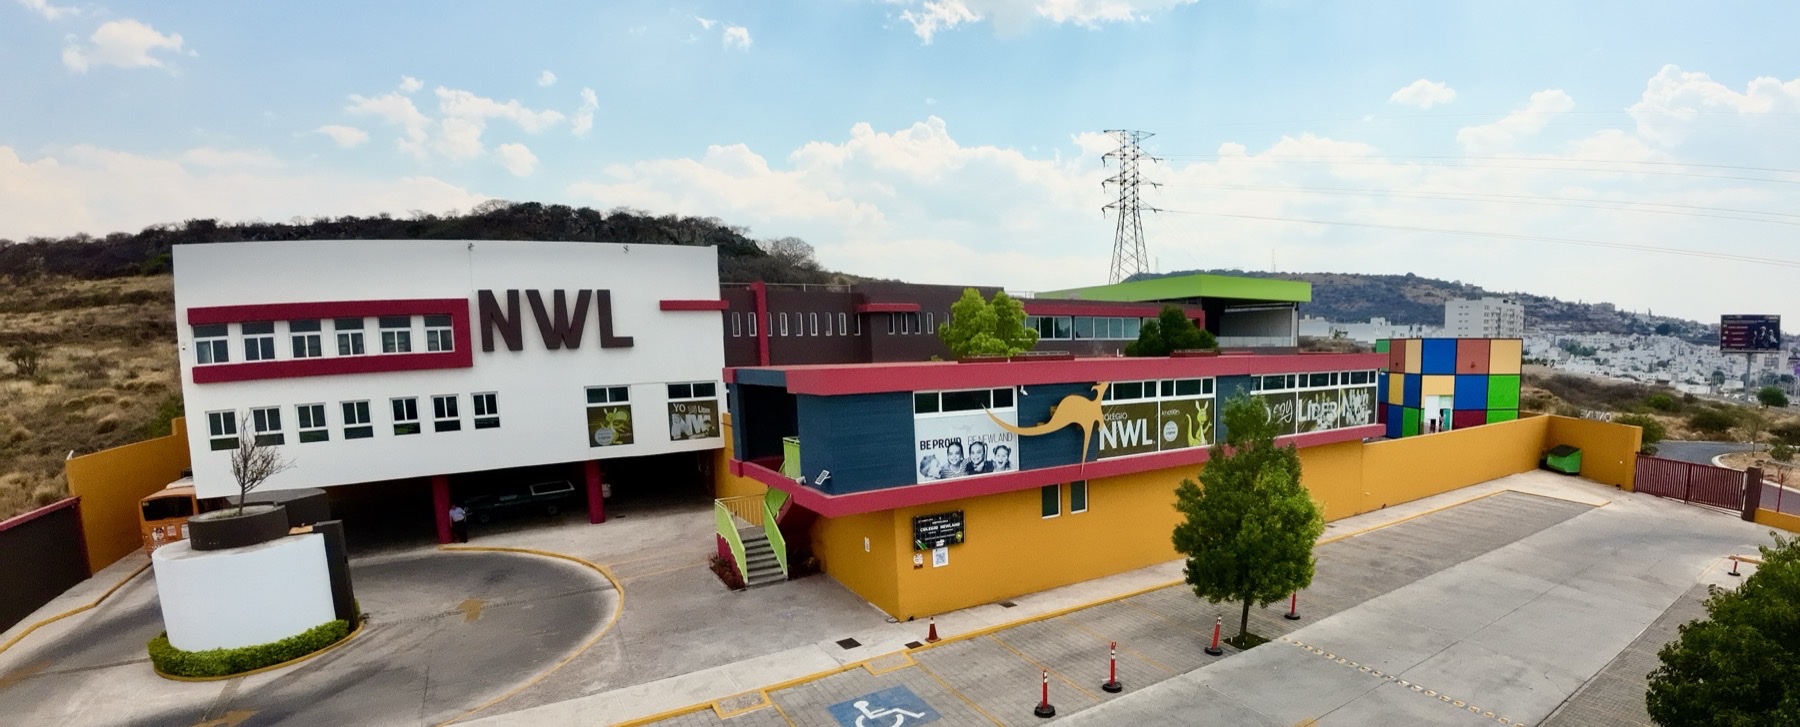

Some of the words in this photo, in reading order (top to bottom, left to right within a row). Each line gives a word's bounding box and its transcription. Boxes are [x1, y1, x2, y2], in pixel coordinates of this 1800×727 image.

[478, 289, 634, 352] NWL
[673, 403, 686, 412] YO
[1103, 412, 1128, 421] OLEGIO
[920, 440, 931, 451] BE
[932, 437, 962, 449] PROUD
[967, 435, 976, 445] BE
[976, 432, 1013, 444] NEWLAND
[1099, 418, 1153, 450] NWL
